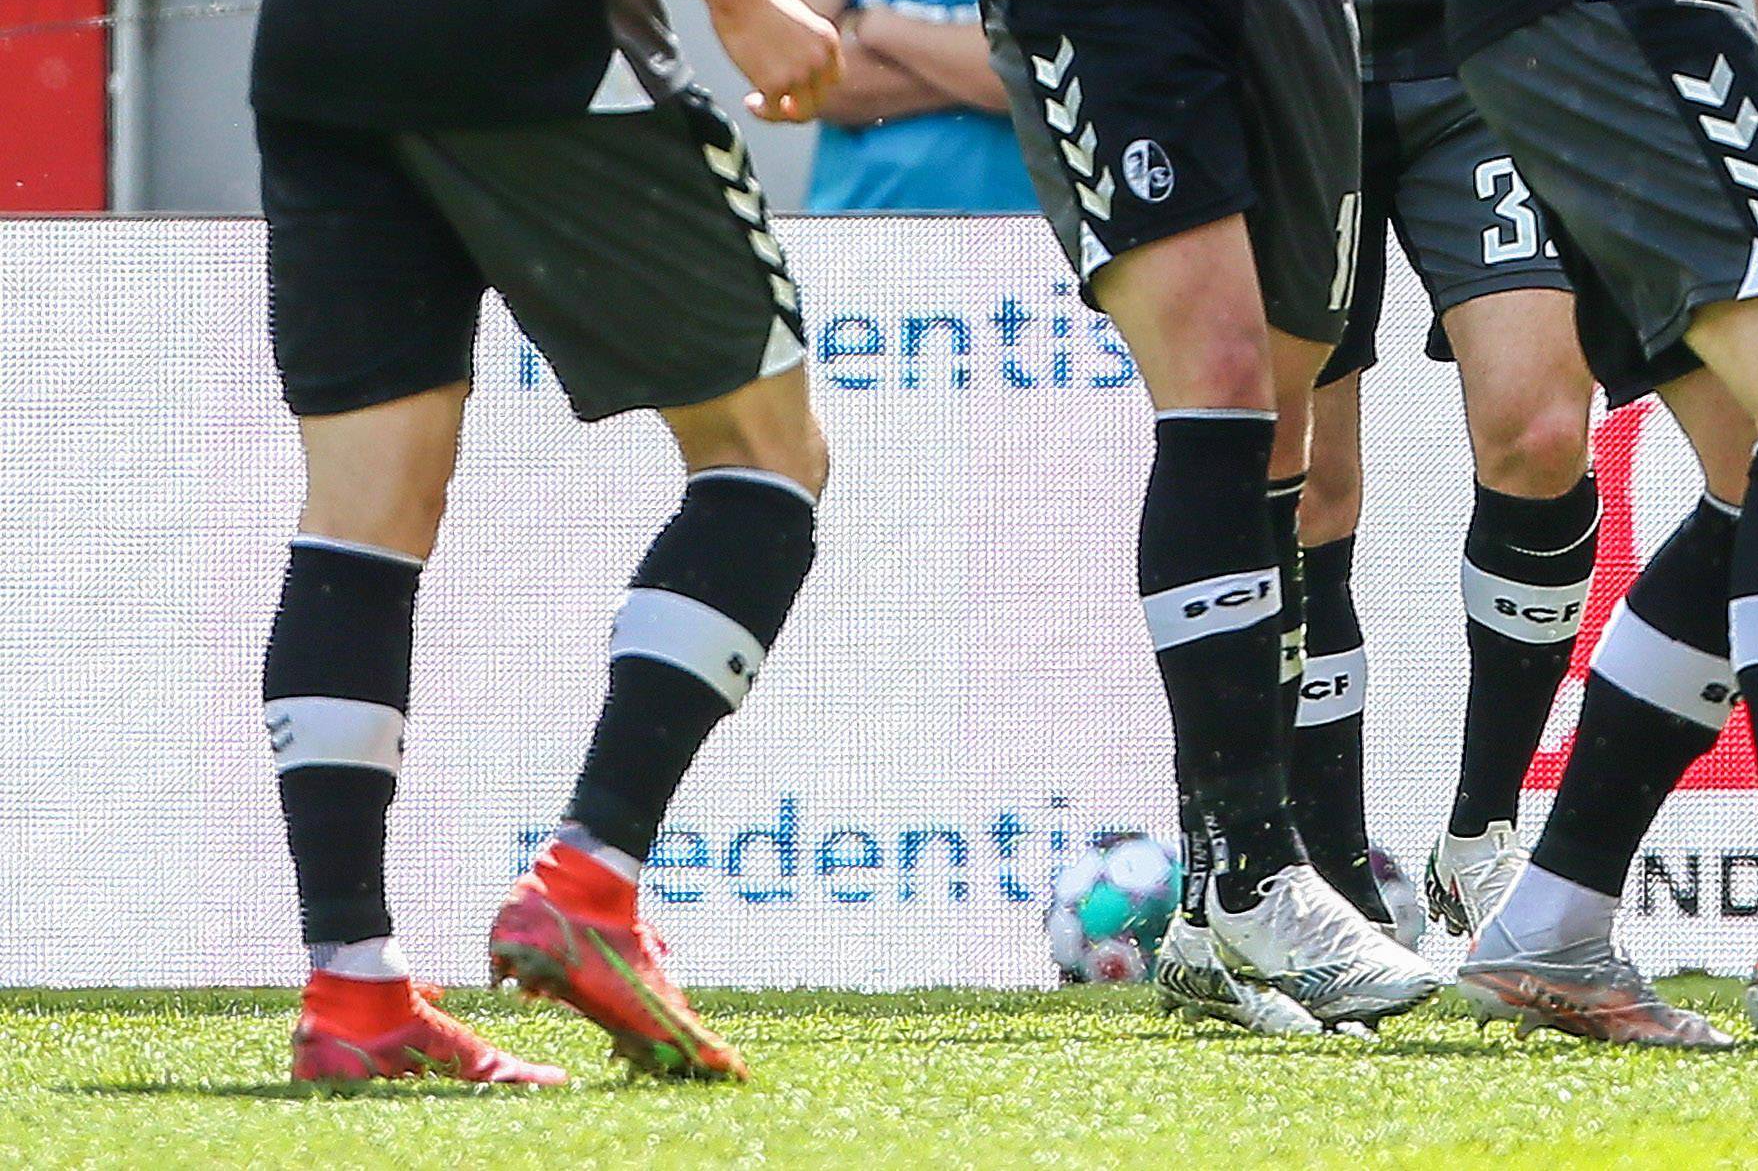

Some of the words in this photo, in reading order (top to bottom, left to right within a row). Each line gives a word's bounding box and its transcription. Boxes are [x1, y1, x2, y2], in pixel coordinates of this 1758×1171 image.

[1474, 156, 1560, 266] 3
[1327, 191, 1362, 311] 1
[1182, 579, 1273, 619] SCF
[1493, 596, 1580, 624] SCF
[1301, 674, 1350, 701] CF
[515, 790, 1150, 903] edenti
